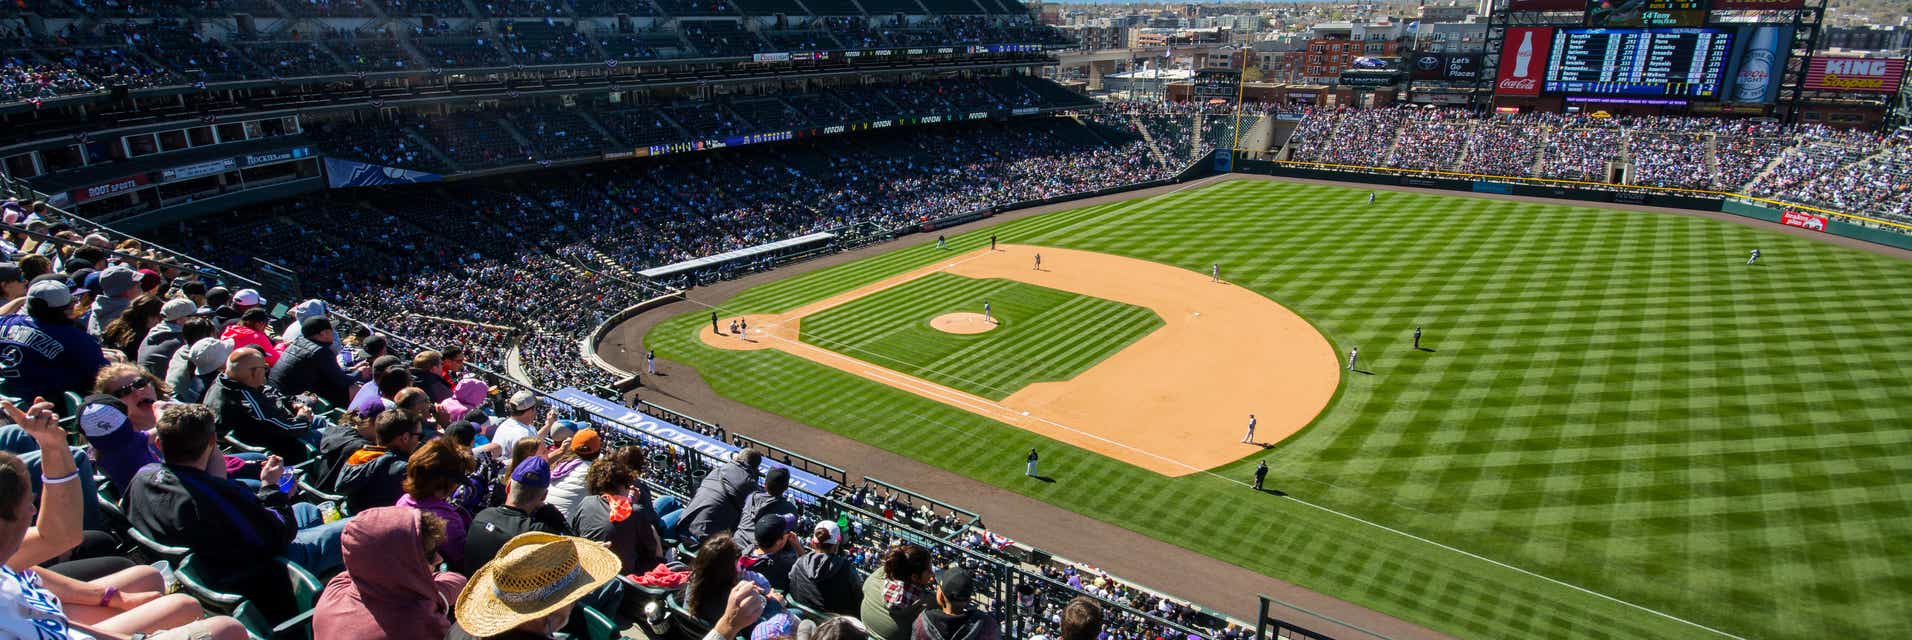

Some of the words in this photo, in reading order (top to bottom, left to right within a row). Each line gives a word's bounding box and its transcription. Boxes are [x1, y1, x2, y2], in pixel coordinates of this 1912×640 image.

[1825, 60, 1886, 76] KING
[88, 185, 110, 197] ROOT
[111, 180, 136, 192] SPORTS
